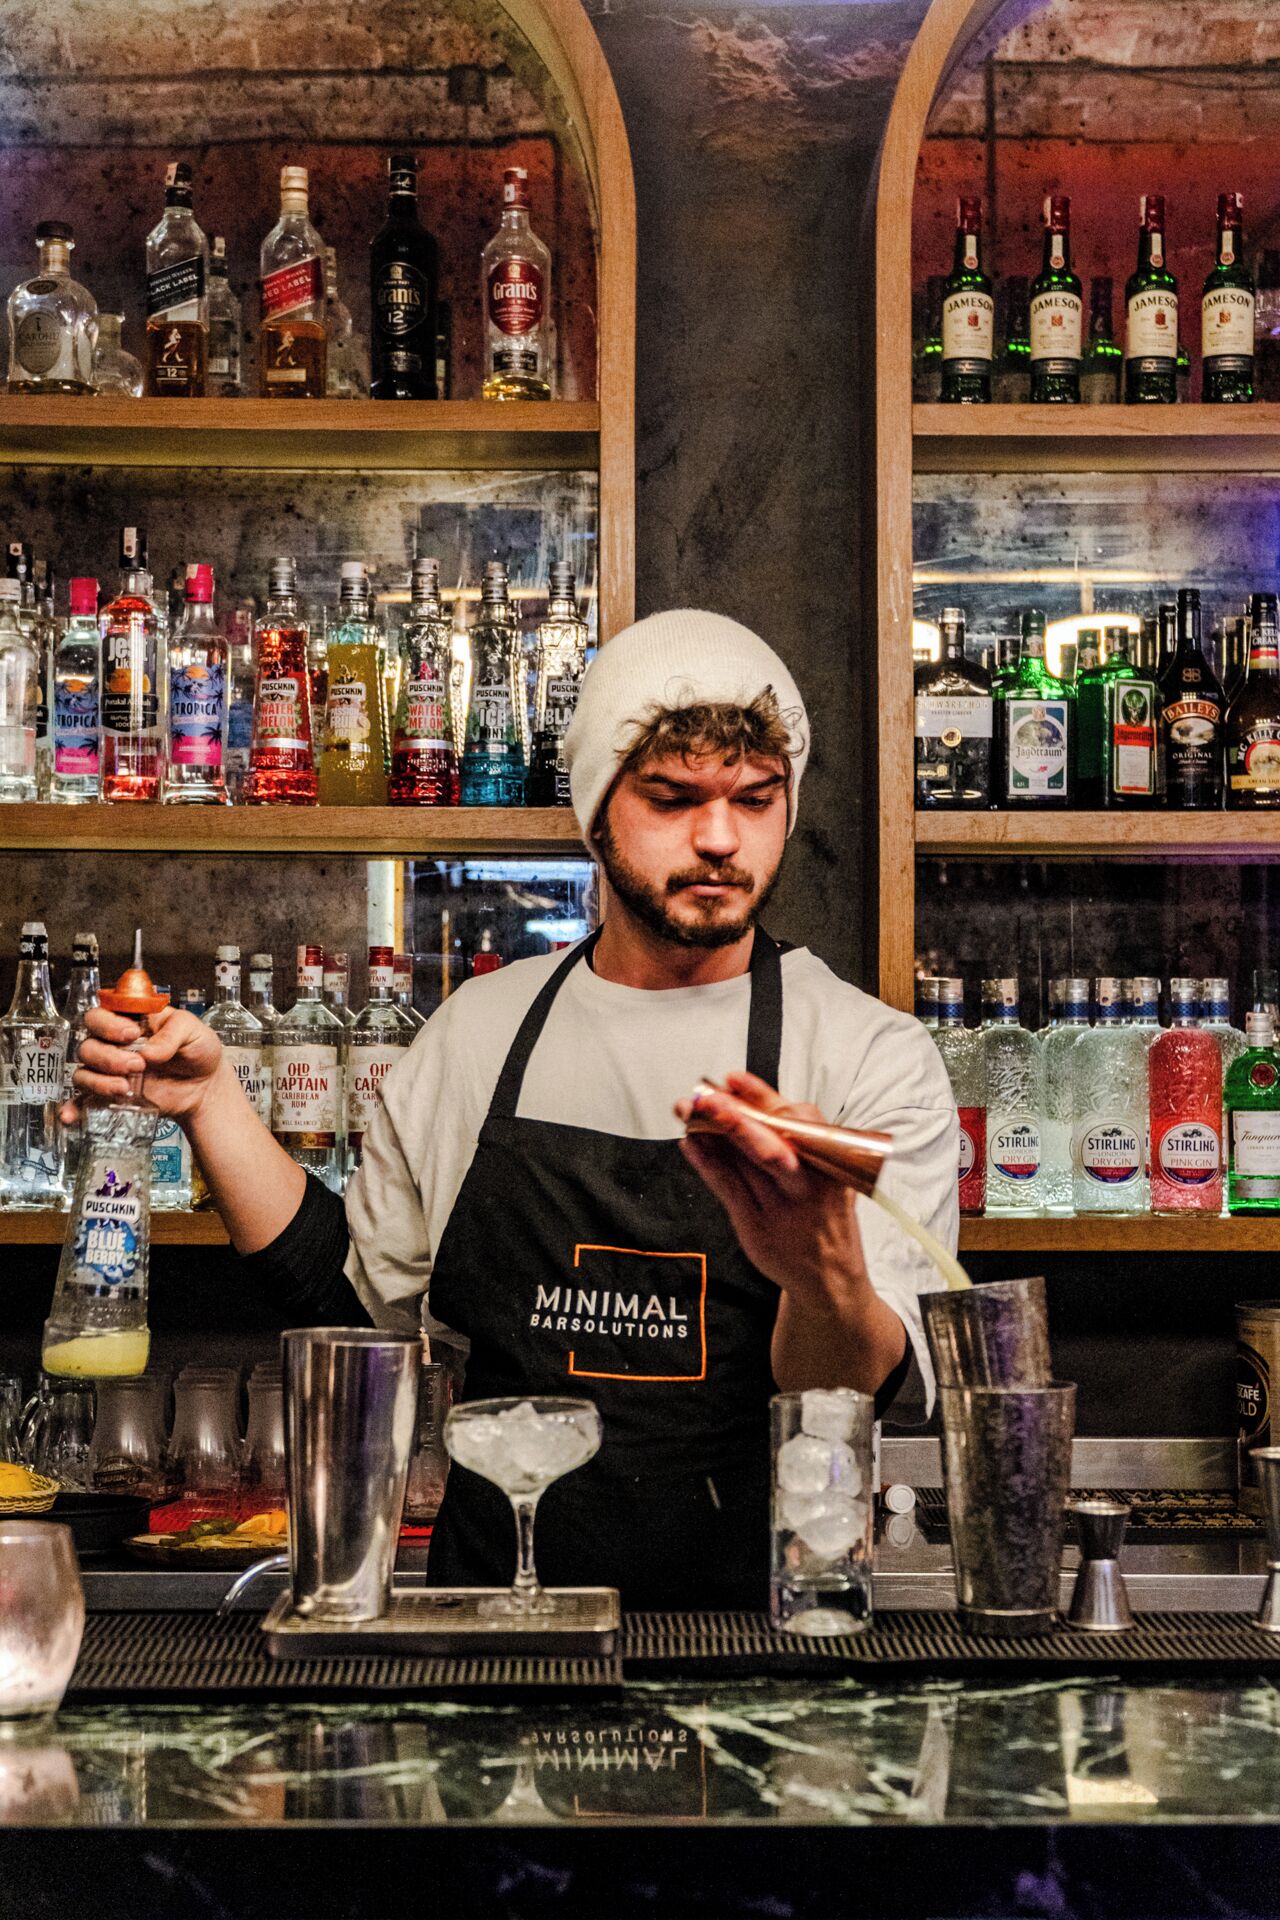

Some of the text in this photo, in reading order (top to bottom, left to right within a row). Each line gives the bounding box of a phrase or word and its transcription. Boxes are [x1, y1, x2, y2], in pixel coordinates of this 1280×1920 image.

[149, 283, 171, 296] LACK
[172, 274, 198, 288] LABEL
[281, 275, 312, 292] LABEL
[493, 282, 537, 300] Grant's
[1033, 296, 1080, 314] JAMESON
[1134, 295, 1178, 312] JAMESO
[1203, 293, 1251, 312] JAMESON
[388, 310, 404, 323] 12
[166, 367, 178, 378] 12
[261, 683, 296, 692] PUSCHKIN
[331, 687, 363, 696] PUSCHKIN
[409, 684, 444, 693] PUSCHKIN
[476, 689, 510, 698] PUSCHKIN
[551, 684, 580, 693] PUSCHK
[175, 702, 217, 716] TROPICA
[260, 703, 294, 715] WATER
[409, 704, 443, 716] WATER
[1167, 702, 1218, 719] BAILEYS
[260, 716, 295, 728] MELON
[409, 717, 443, 729] MELON
[480, 708, 506, 727] ICE
[545, 707, 573, 726] BLA
[1246, 729, 1275, 745] KELLY
[287, 1062, 310, 1077] OLD
[31, 1086, 54, 1095] 1937
[276, 1077, 328, 1092] CAPTAIN
[281, 1091, 320, 1100] CARIBBEAN
[998, 1135, 1040, 1148] STIRLING
[1241, 1130, 1280, 1143] Tanquer
[1087, 1137, 1136, 1150] STIRLING
[1167, 1138, 1215, 1152] STIRLING
[1002, 1155, 1022, 1163] DRY
[1092, 1157, 1132, 1166] DRY GIN
[1170, 1158, 1213, 1168] PINK GIN
[85, 1200, 137, 1216] PUSCHKIN
[87, 1229, 127, 1251] BLUE
[85, 1249, 125, 1265] BERRY
[535, 1284, 688, 1321] MINIMAL
[530, 1313, 688, 1339] BARSOLUTIONS
